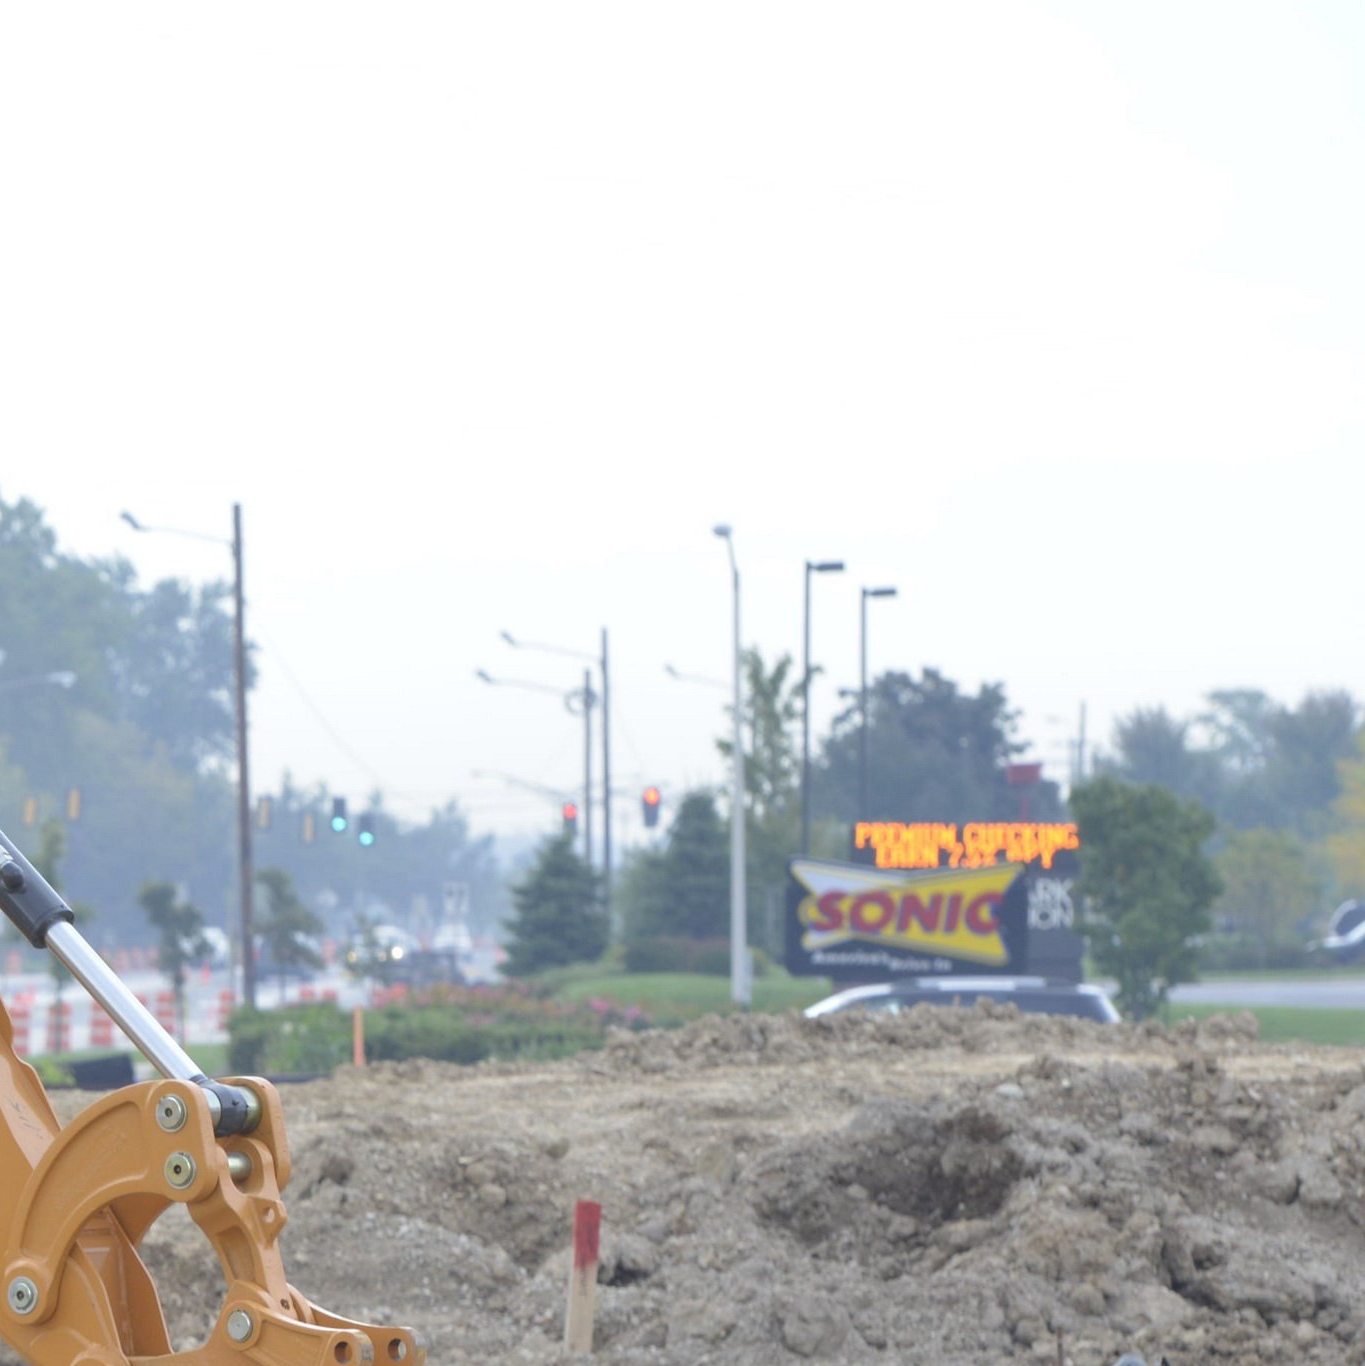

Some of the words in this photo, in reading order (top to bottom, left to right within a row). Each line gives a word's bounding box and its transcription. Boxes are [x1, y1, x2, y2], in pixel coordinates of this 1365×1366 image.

[855, 822, 957, 849] PREMIUM
[963, 822, 1079, 849] CHECKING
[809, 888, 1005, 936] SONIC
